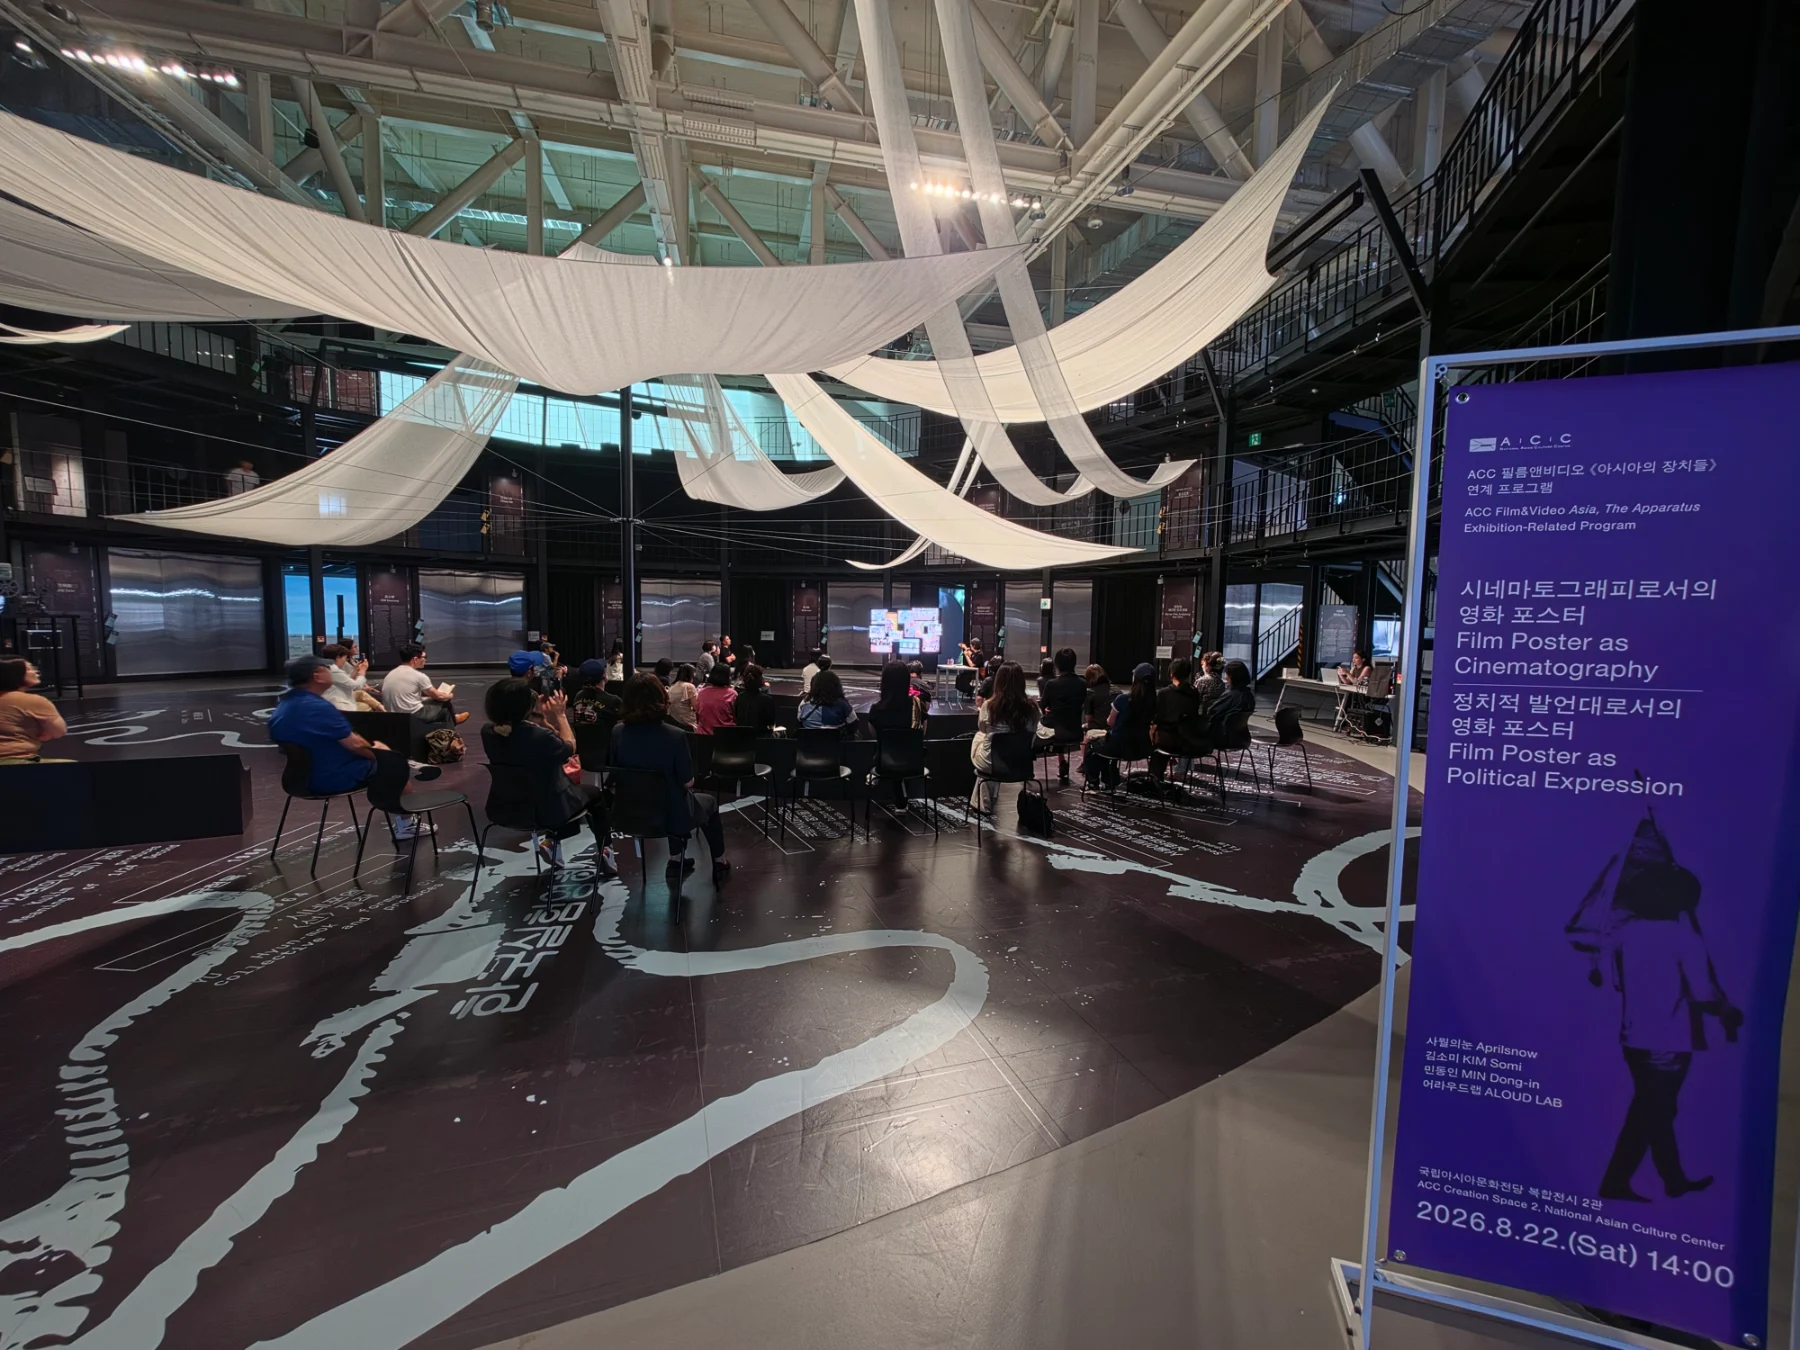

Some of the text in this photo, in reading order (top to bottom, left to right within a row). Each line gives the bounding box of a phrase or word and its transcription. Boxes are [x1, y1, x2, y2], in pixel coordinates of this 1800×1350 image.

[1467, 458, 1717, 480] ACC 필름앤비디오 《아시아의 장치들》
[1467, 482, 1554, 496] 연계 프로그램
[1465, 502, 1700, 517] ACC Film&Video Asia, The Apparatus
[1464, 520, 1636, 533] Exhibition-Related Program
[1461, 579, 1716, 600] 시네마토그래피로서의
[1460, 604, 1586, 626] 영화 포스터
[1456, 631, 1629, 652] Film Poster as
[1455, 656, 1658, 682] Cinematography
[1452, 692, 1682, 719] 정치적 발언대로서의
[1452, 717, 1574, 741] 영화 포스터
[1448, 742, 1616, 767] Film Poster as
[1446, 767, 1684, 797] Political Expression
[342, 916, 372, 930] and
[1425, 1050, 1522, 1072] 김소미 KIM Somi
[1476, 1042, 1538, 1060] Aprilsnow
[1461, 1069, 1487, 1082] MIN
[1489, 1073, 1540, 1090] Dong-in
[1484, 1087, 1532, 1103] ALOUD
[1535, 1095, 1563, 1108] LAB
[1418, 1166, 1604, 1212] 국립아시아문화전당 복합전시 2관
[1417, 1180, 1442, 1192] ACC
[1443, 1184, 1490, 1202] Creation
[1492, 1194, 1528, 1212] Space
[1544, 1204, 1593, 1223] National
[1594, 1216, 1629, 1231] Asian
[1632, 1222, 1678, 1242] Culture
[1680, 1232, 1726, 1252] Center
[1417, 1200, 1735, 1289] 2026.8.22.(Sat) 14:00
